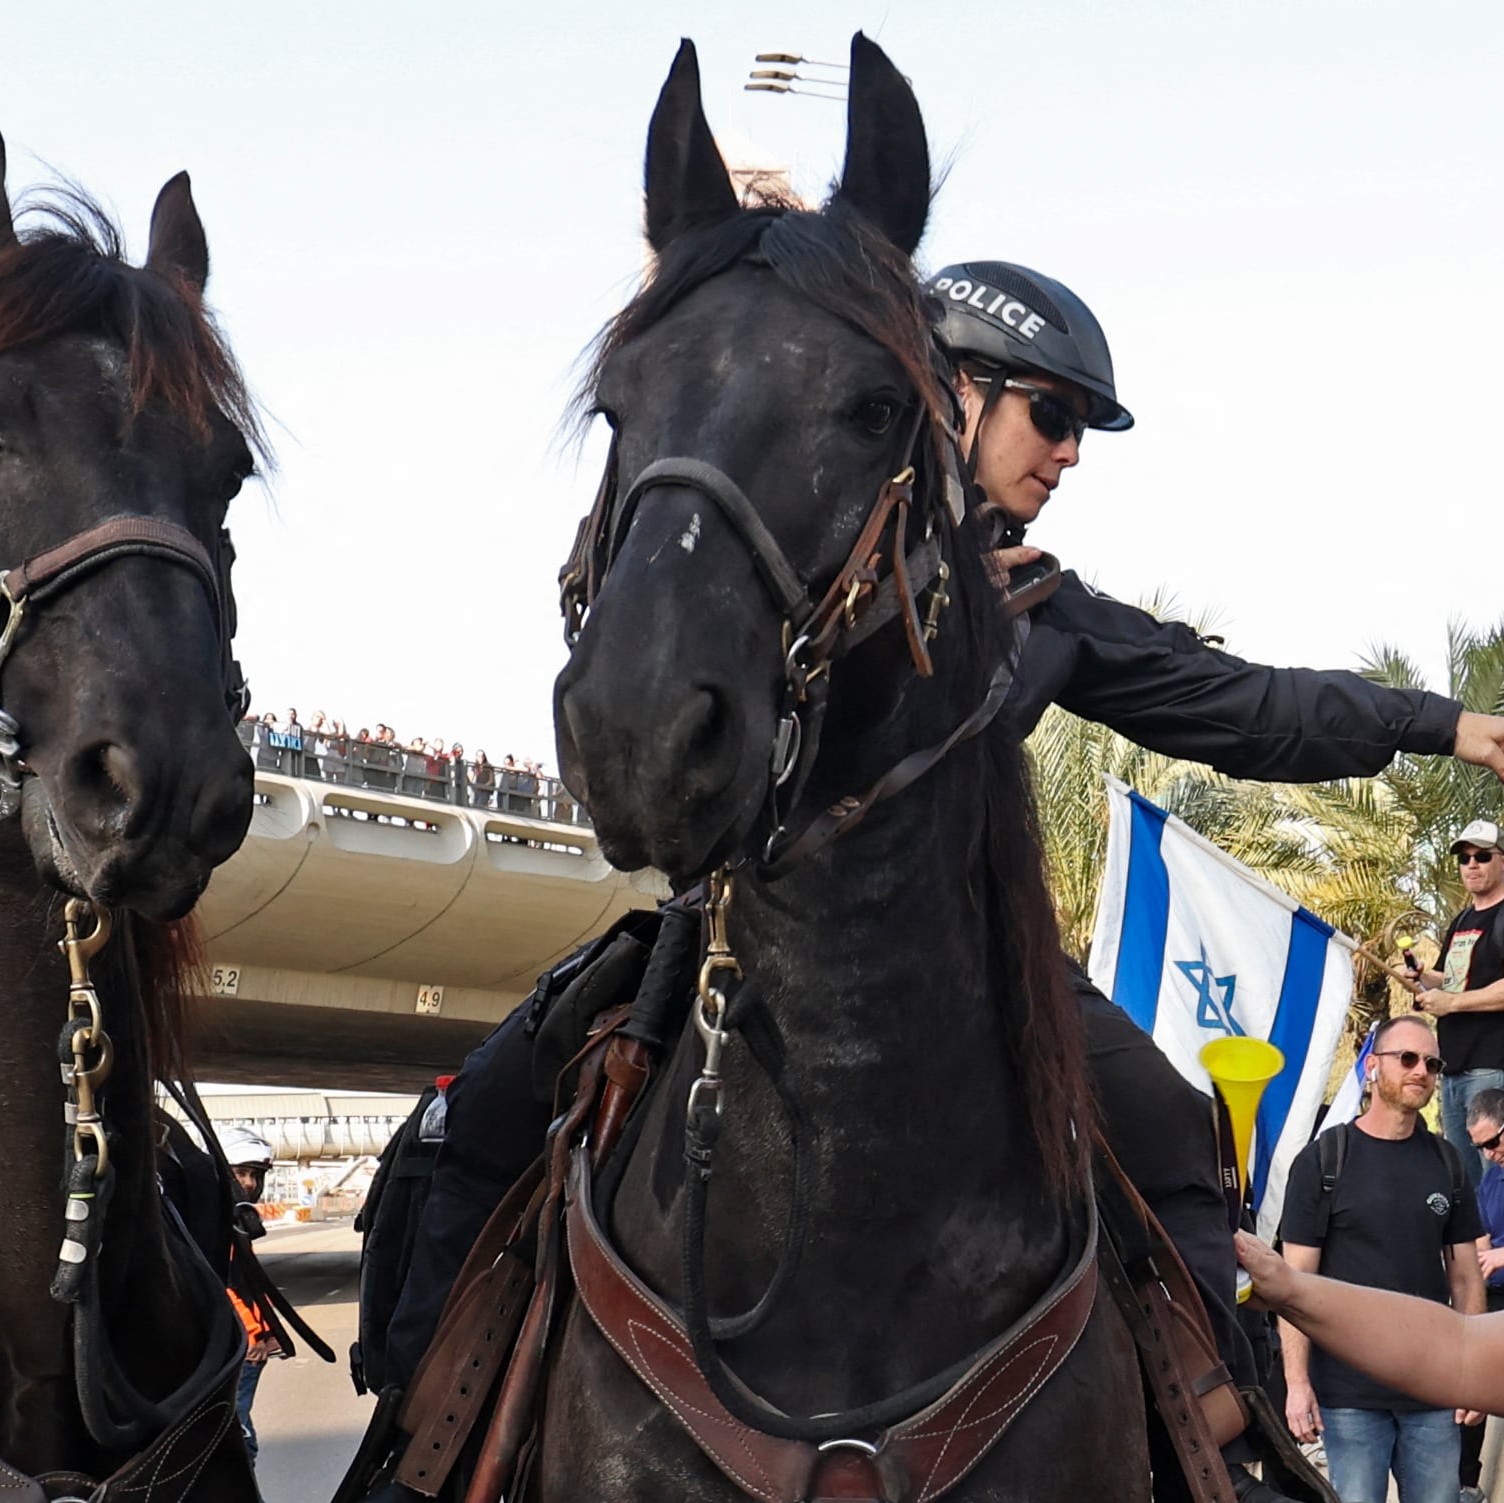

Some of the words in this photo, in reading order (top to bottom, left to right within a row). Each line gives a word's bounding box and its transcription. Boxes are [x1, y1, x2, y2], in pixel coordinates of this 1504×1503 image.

[929, 278, 1046, 339] POLICE
[212, 969, 238, 988] 5.2
[419, 991, 441, 1008] 4.9
